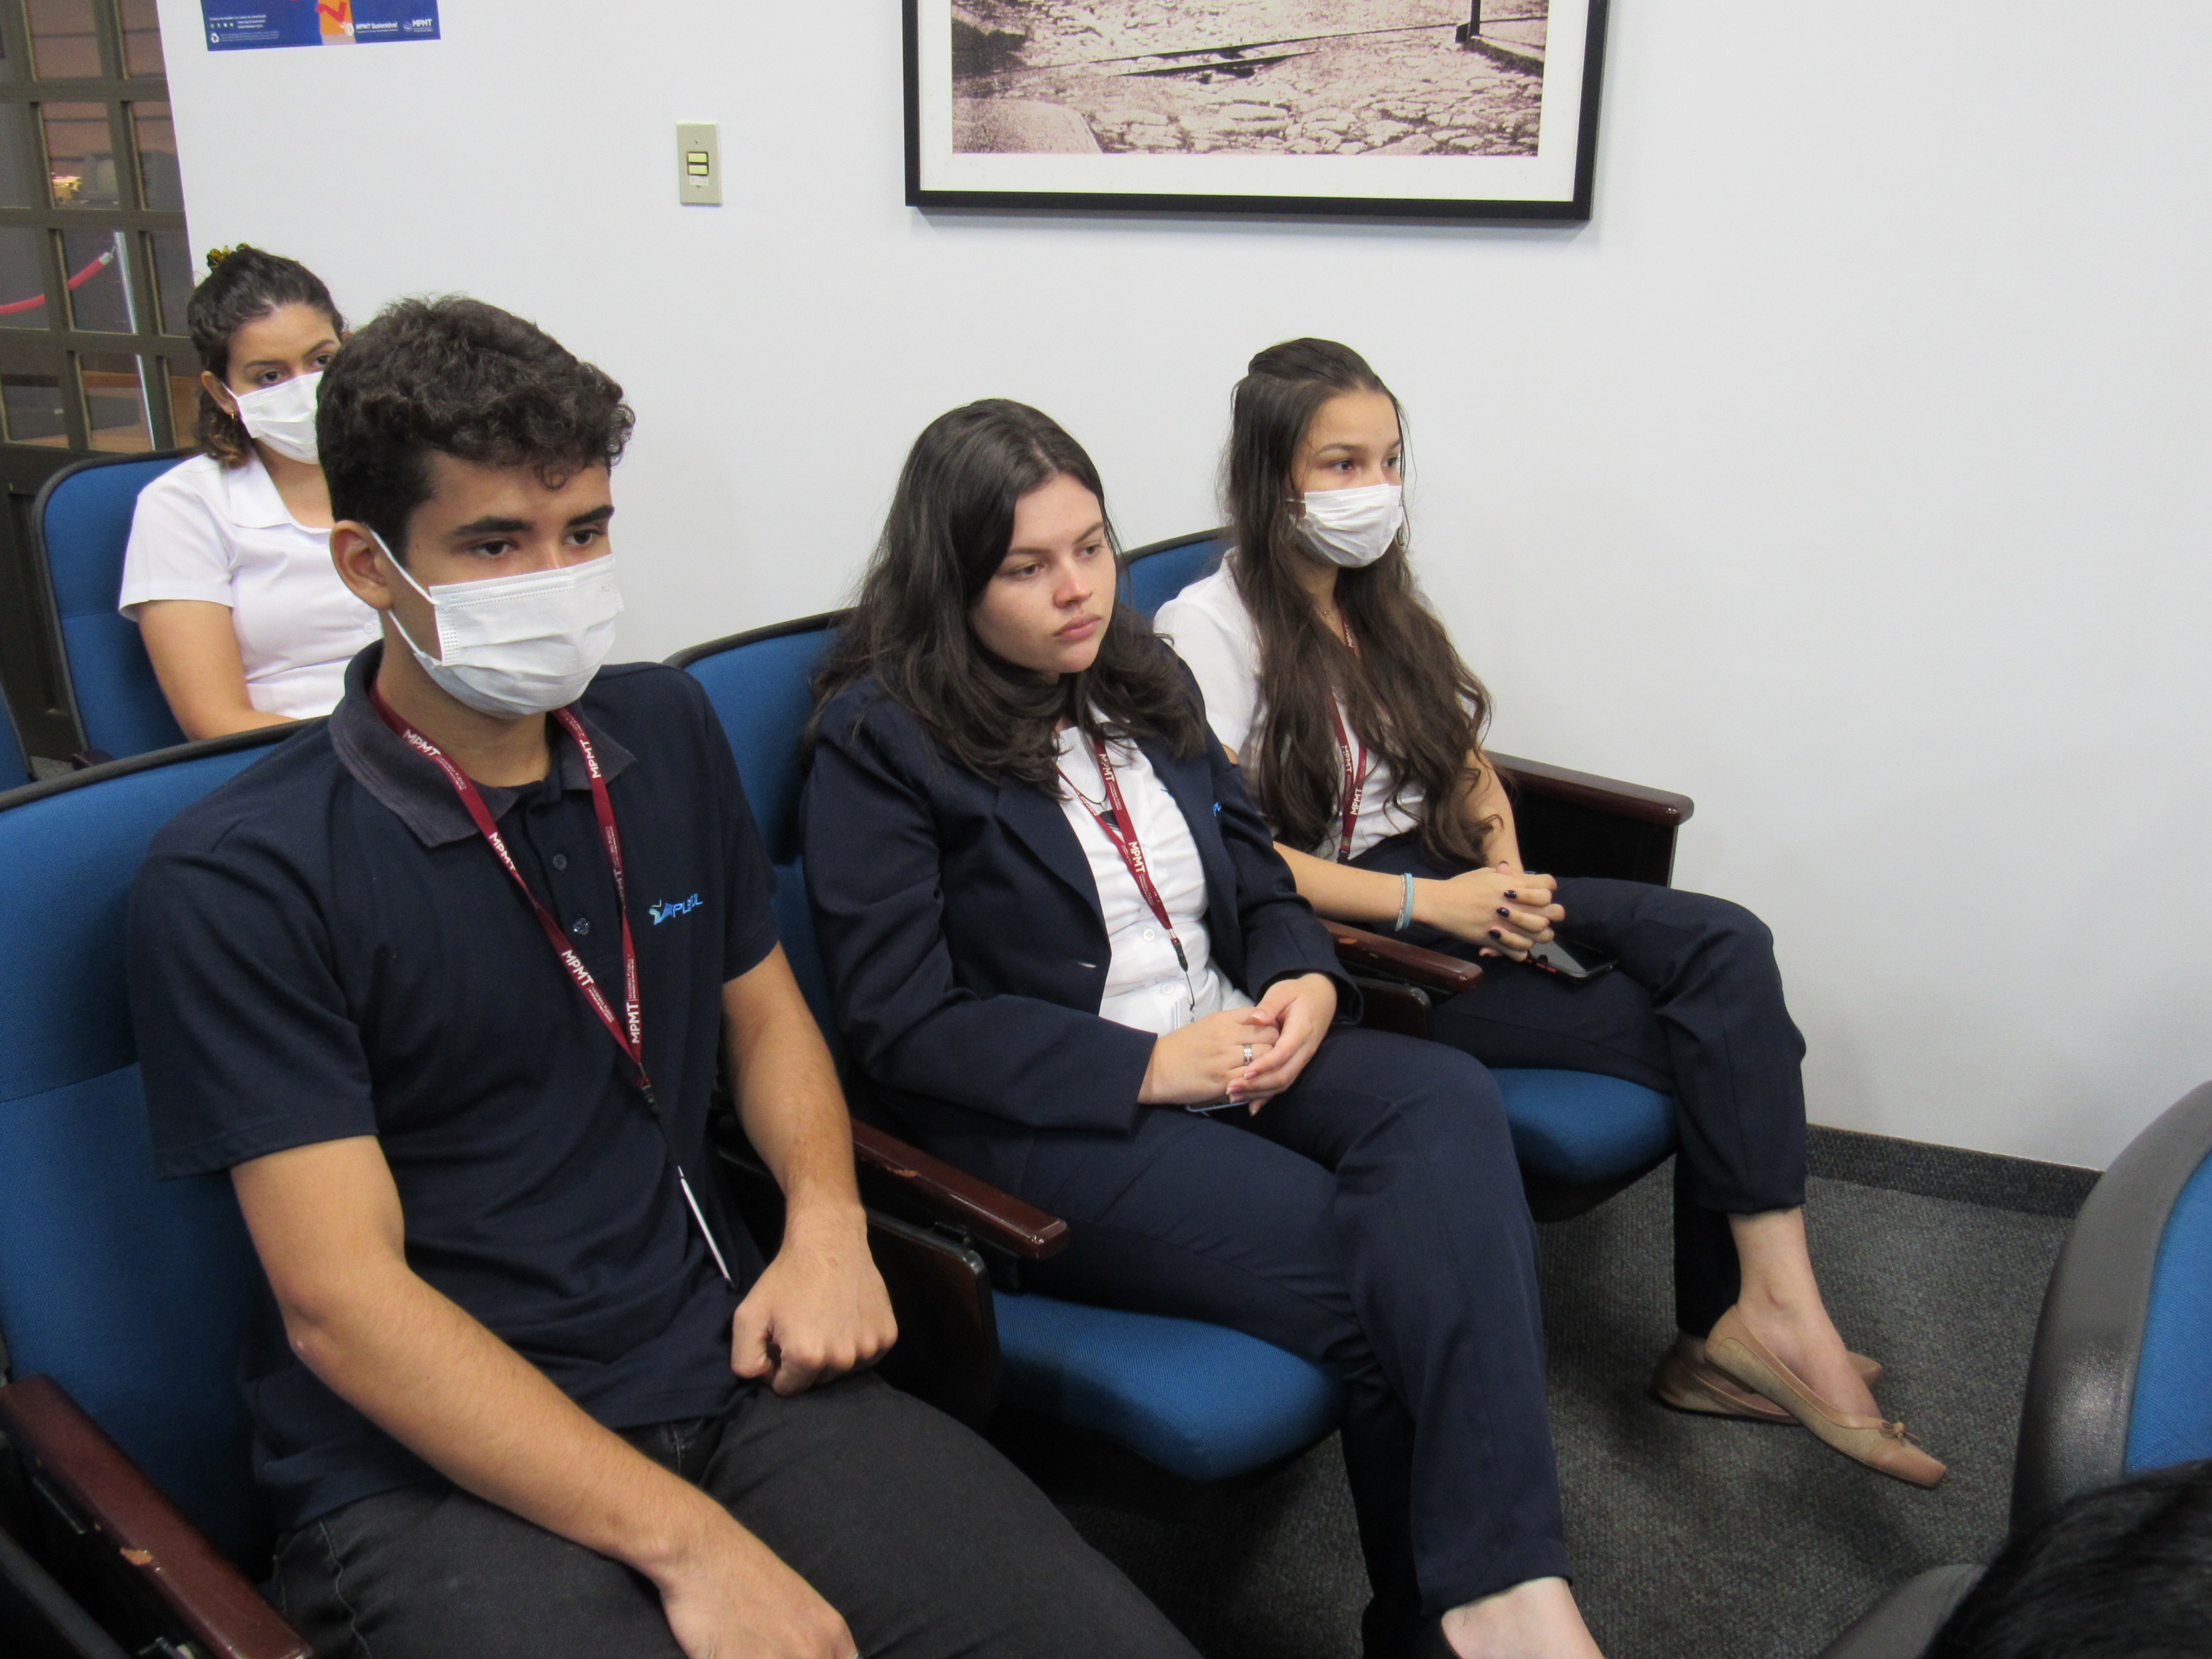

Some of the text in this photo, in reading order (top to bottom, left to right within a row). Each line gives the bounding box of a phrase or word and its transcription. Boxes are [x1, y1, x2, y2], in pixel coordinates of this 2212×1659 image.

[412, 19, 432, 27] MPMT
[403, 729, 441, 756] MPMT
[579, 739, 601, 778] MPMT
[1098, 754, 1115, 781] MPMT
[1350, 788, 1363, 815] MPMT
[489, 832, 516, 870] MPMT
[1128, 842, 1145, 872] MPMT
[562, 949, 594, 985] MPMT
[626, 1002, 640, 1044] MPMT
